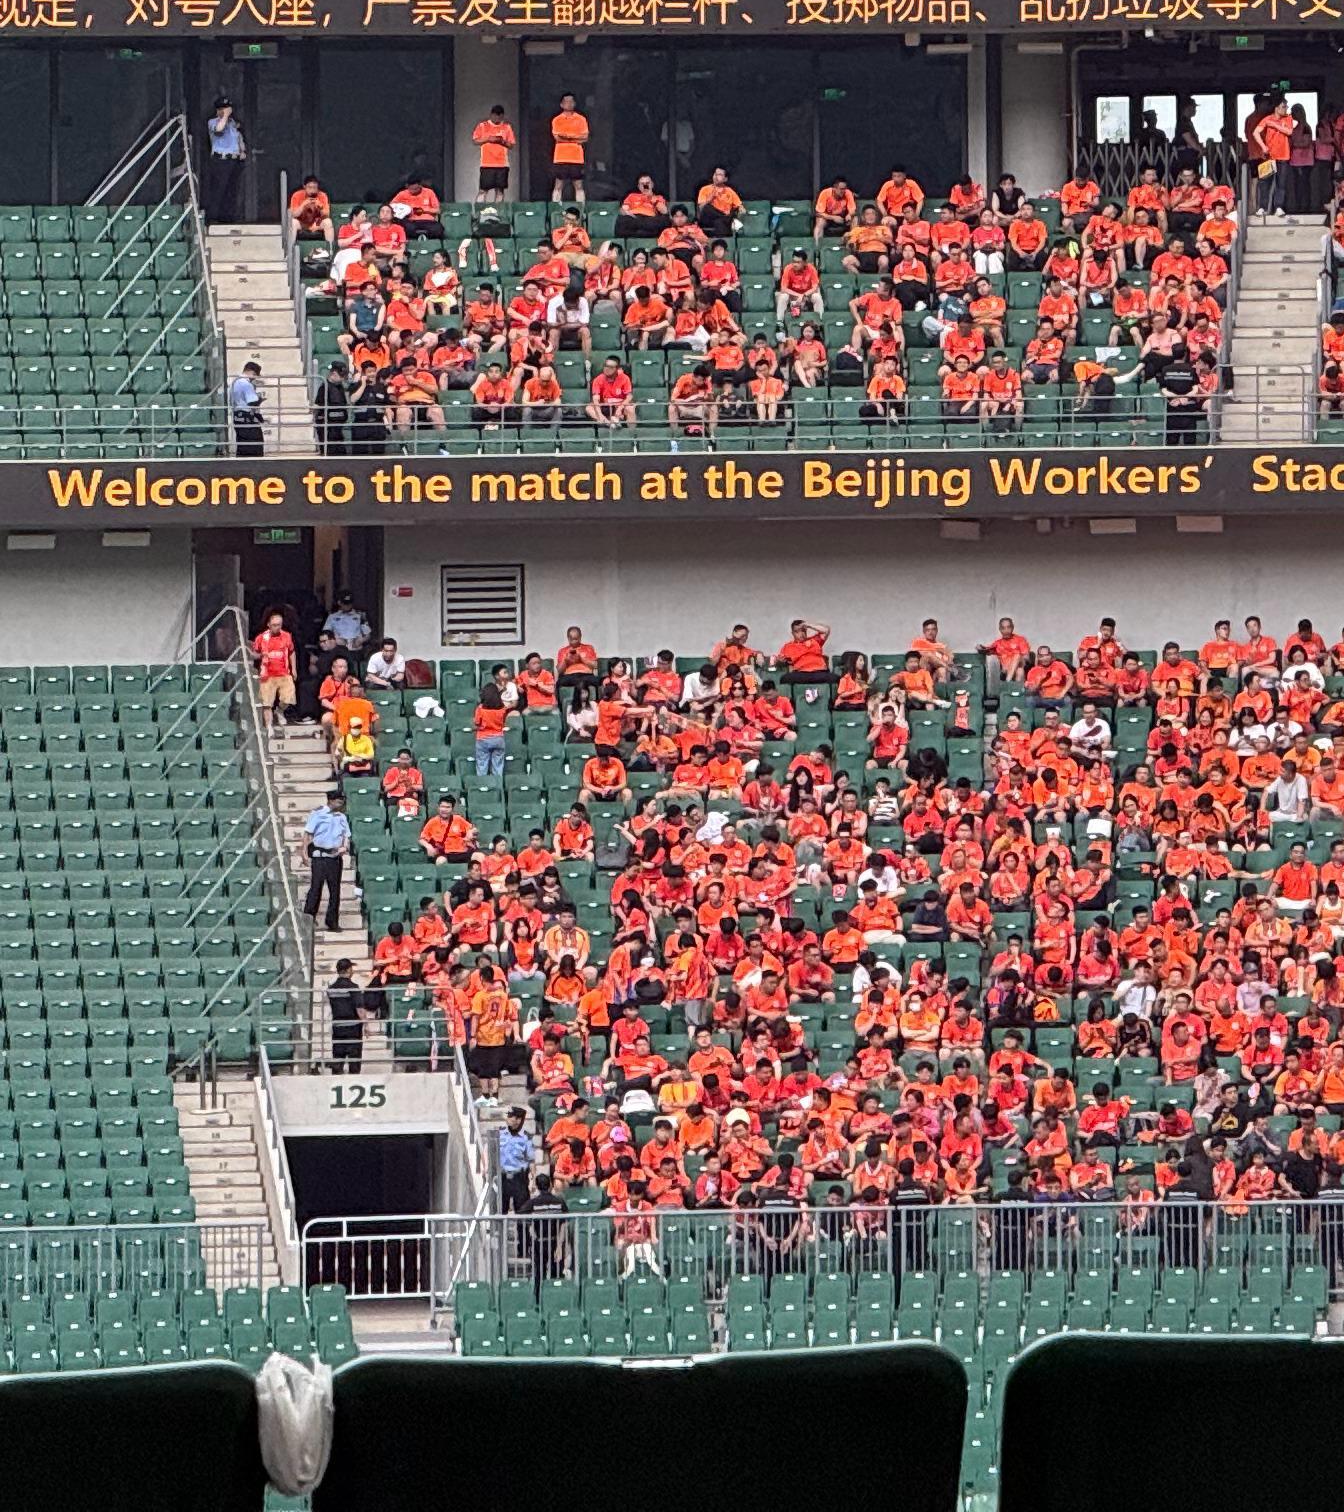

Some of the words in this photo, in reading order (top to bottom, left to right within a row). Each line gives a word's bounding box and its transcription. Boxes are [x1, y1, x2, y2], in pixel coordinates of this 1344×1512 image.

[48, 469, 287, 508] Welcome
[303, 472, 355, 505] to
[370, 464, 453, 504] the
[471, 461, 622, 502] match
[640, 467, 686, 501] at
[703, 461, 784, 500] the
[804, 459, 971, 508] Beijing
[330, 1086, 386, 1108] 125
